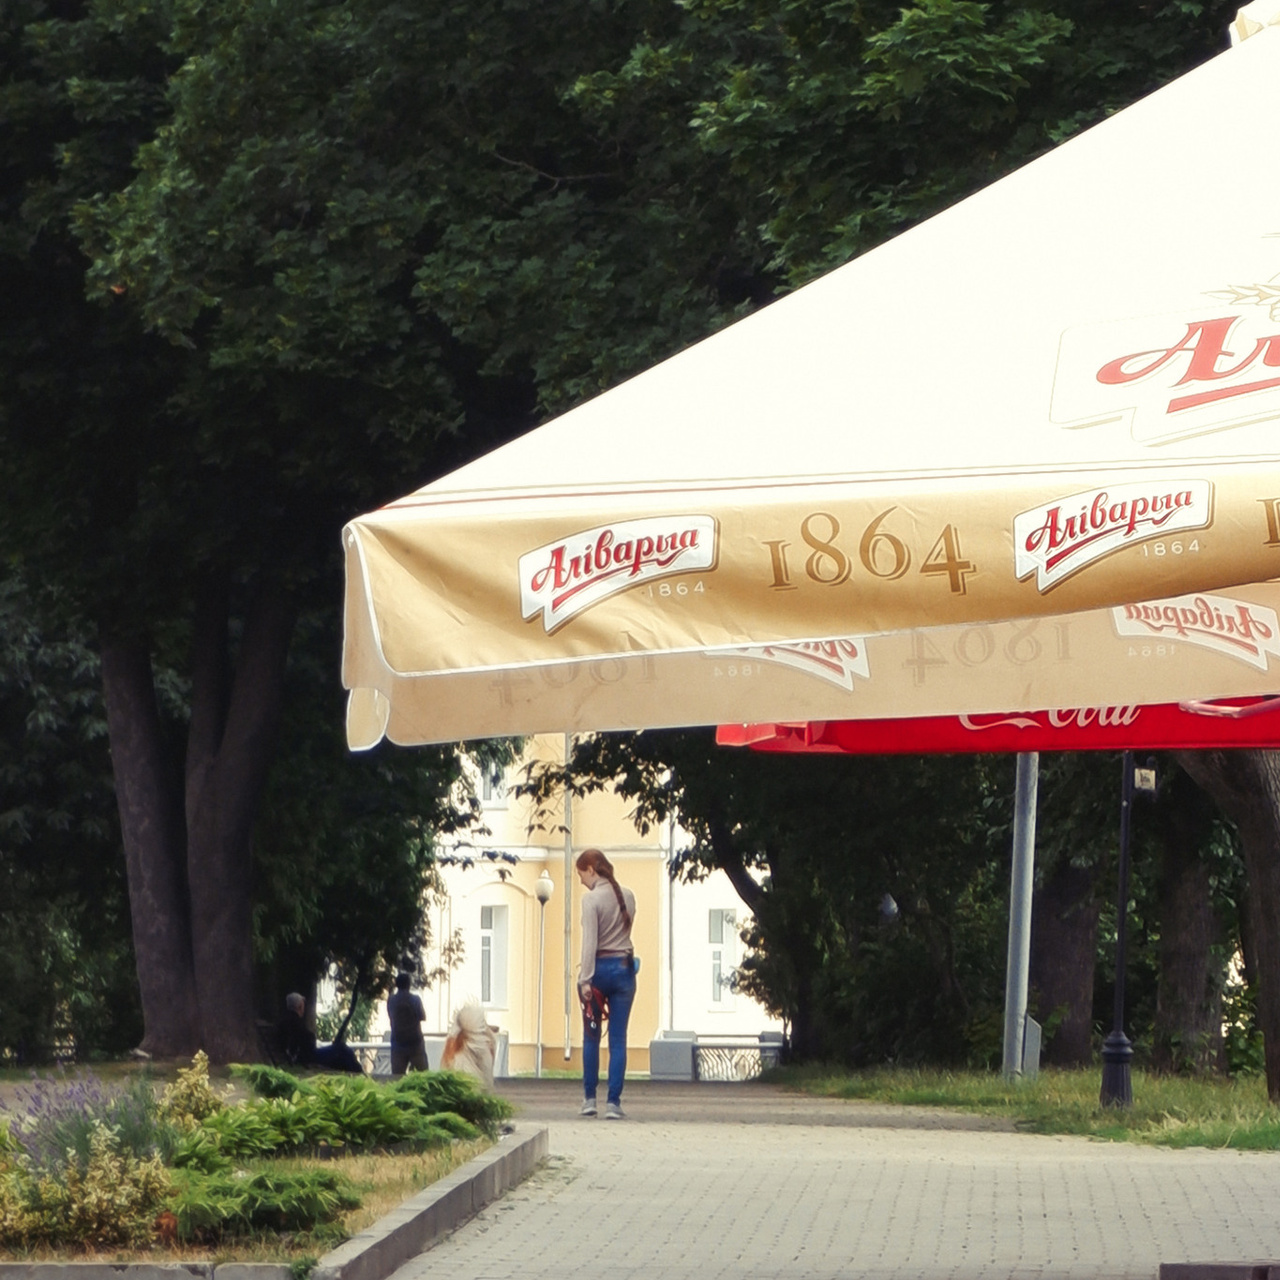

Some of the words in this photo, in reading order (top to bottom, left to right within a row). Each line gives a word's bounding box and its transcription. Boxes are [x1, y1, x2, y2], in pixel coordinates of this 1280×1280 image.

[762, 506, 977, 595] 1864
[1141, 539, 1201, 558] 1864
[647, 580, 706, 599] 1864
